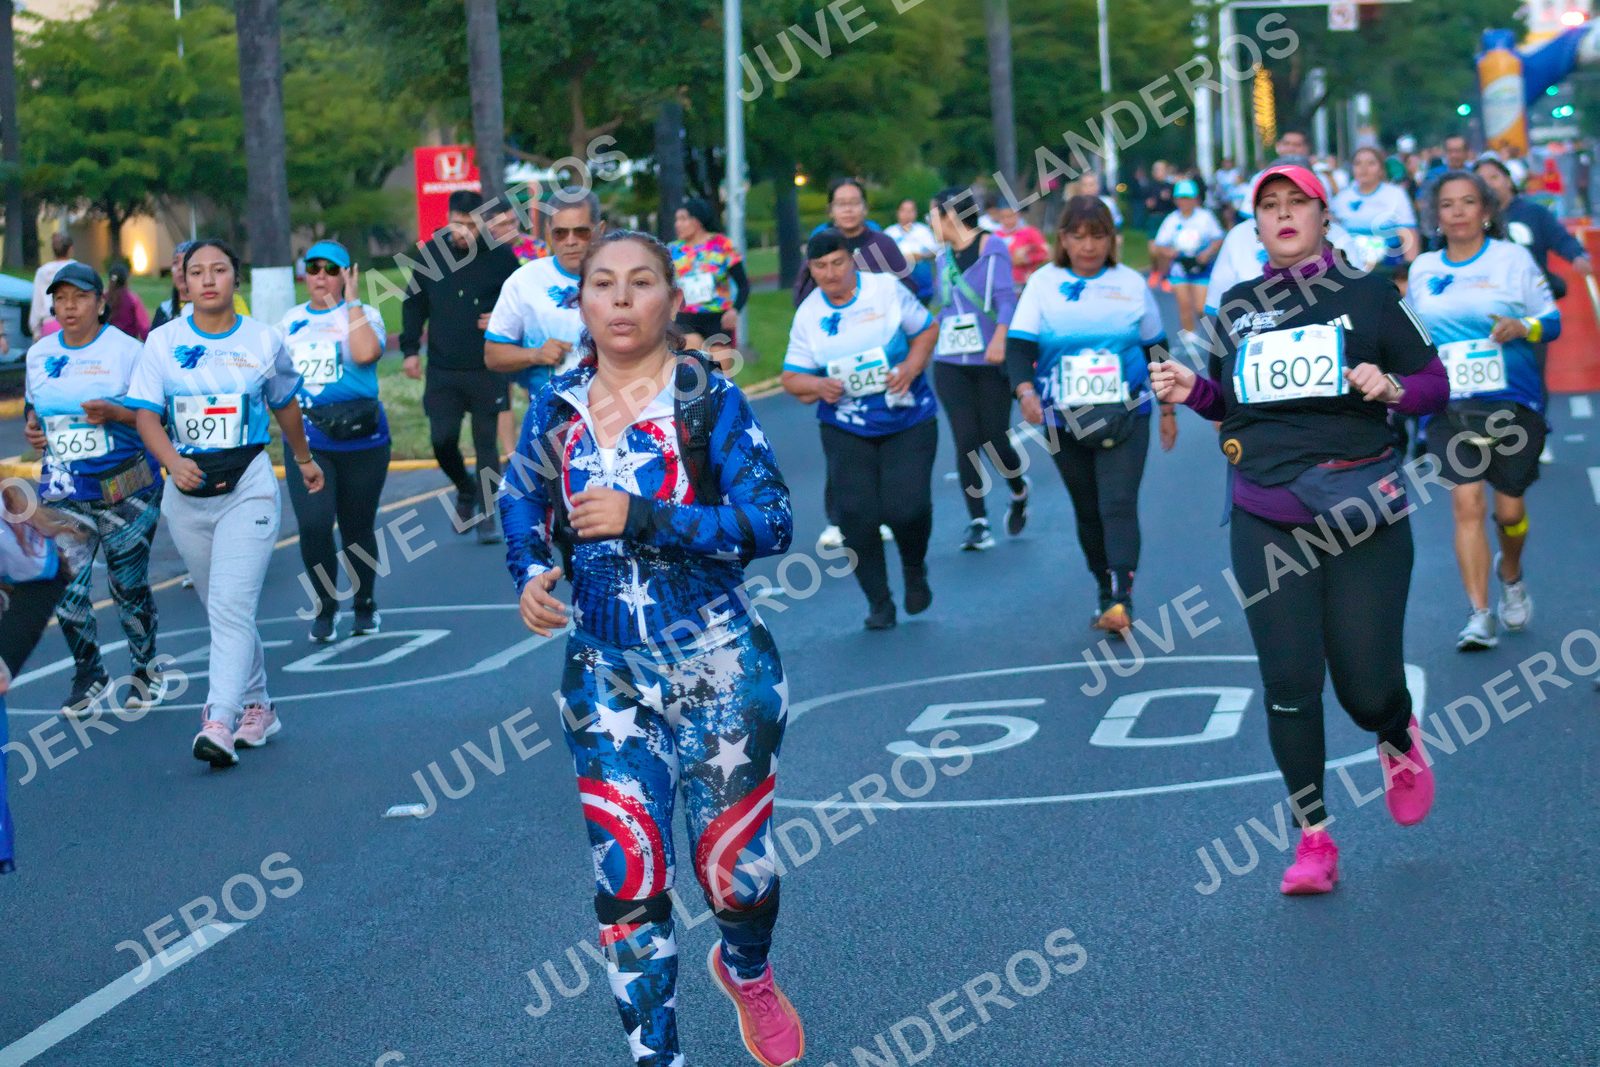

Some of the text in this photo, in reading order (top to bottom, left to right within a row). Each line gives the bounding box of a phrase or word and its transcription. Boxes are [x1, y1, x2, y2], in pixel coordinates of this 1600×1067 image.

[298, 358, 335, 378] 275
[1251, 355, 1334, 392] 1802
[1065, 375, 1118, 397] 1004
[186, 417, 227, 440] 891
[56, 430, 97, 455] 565
